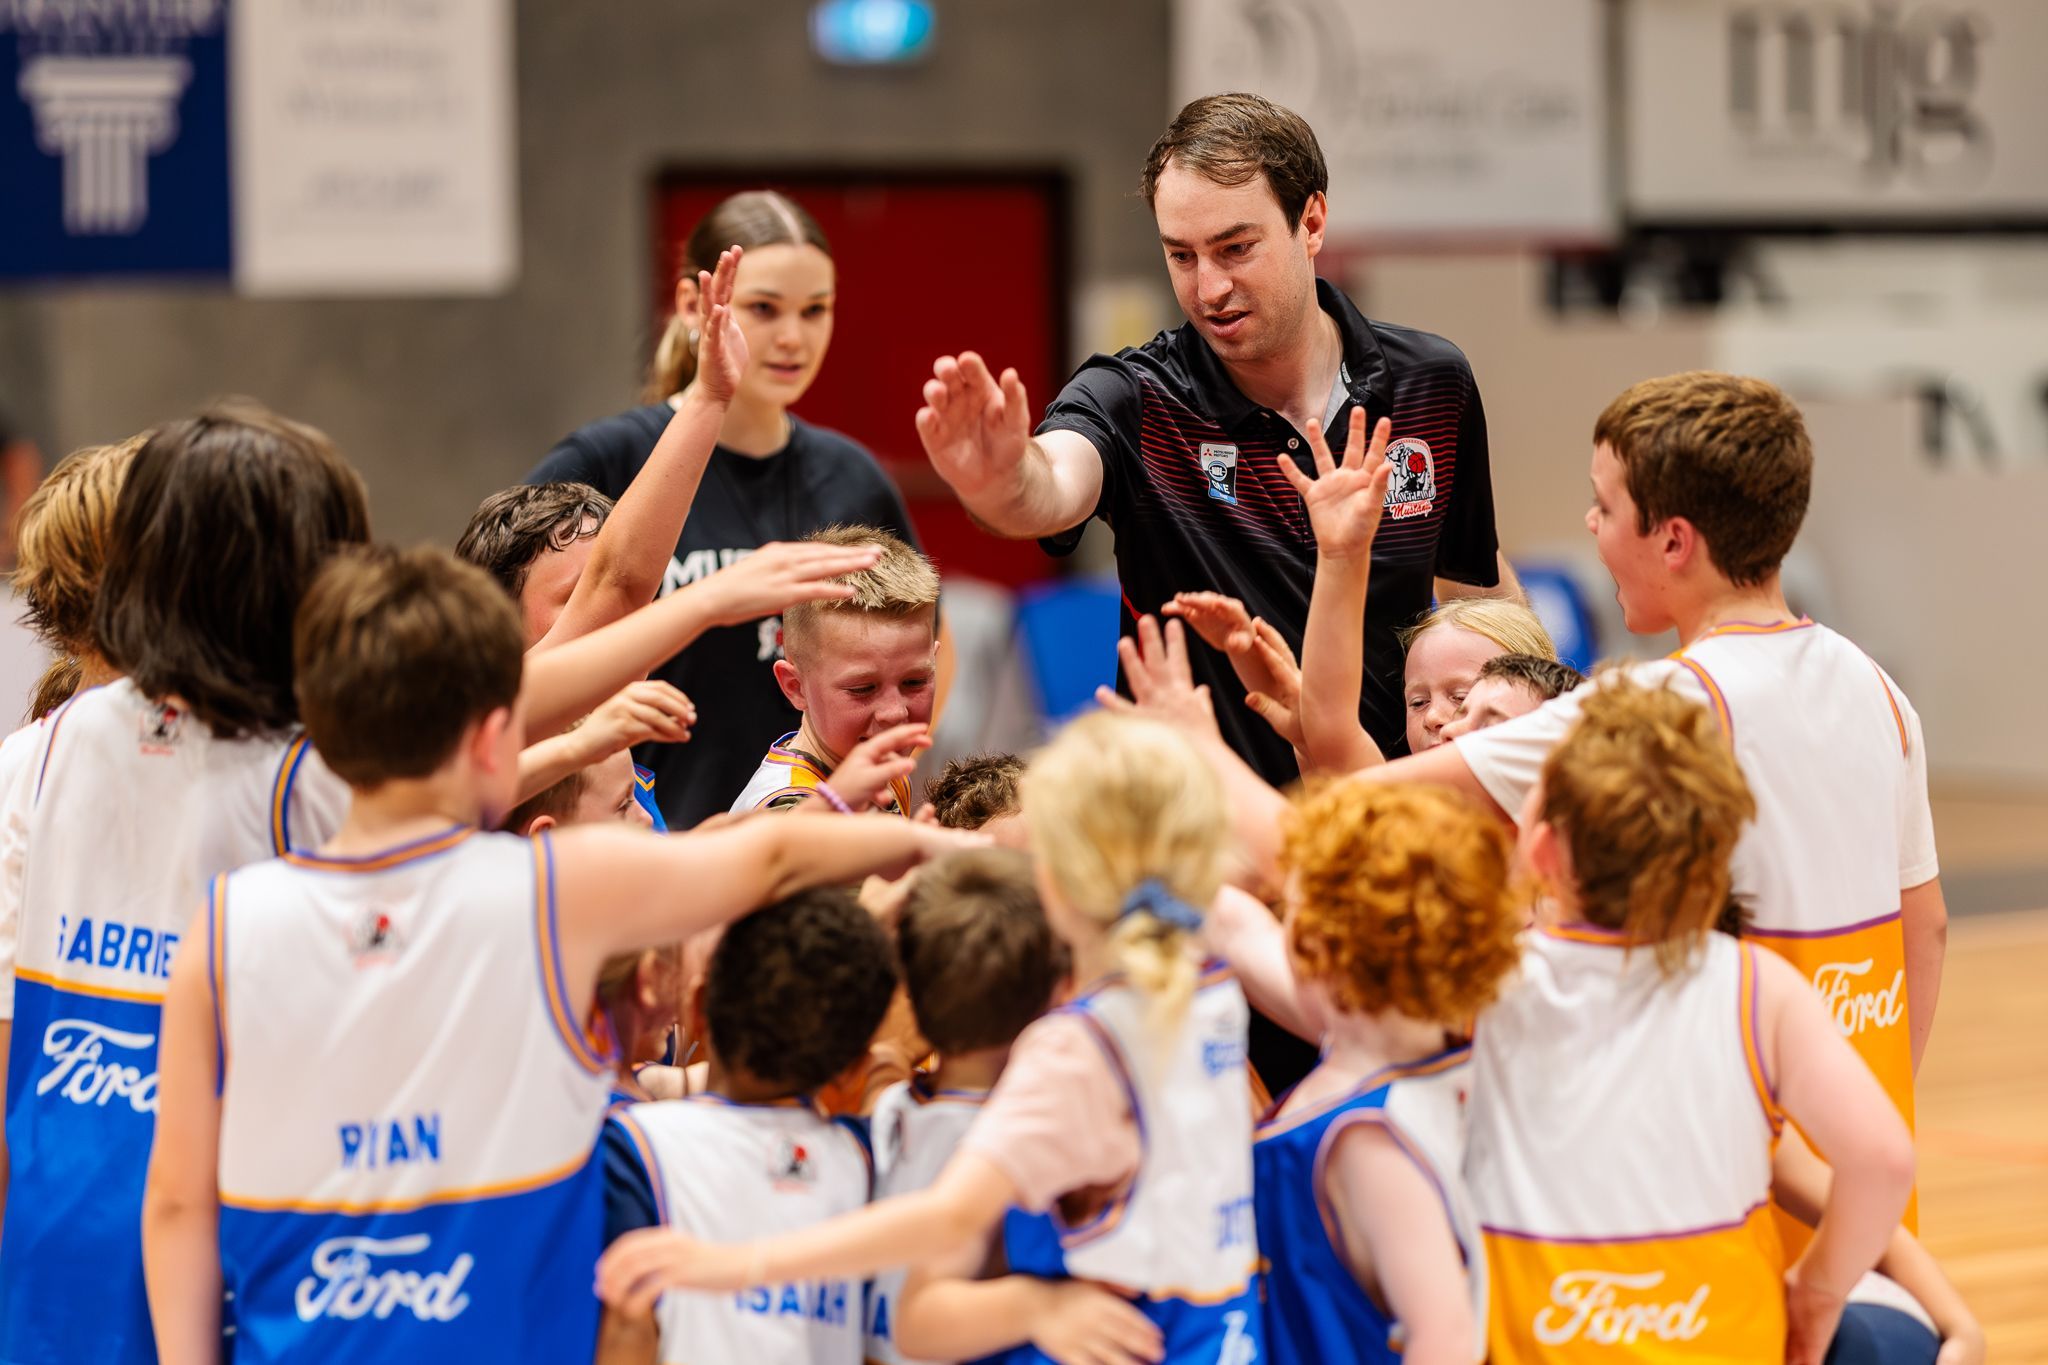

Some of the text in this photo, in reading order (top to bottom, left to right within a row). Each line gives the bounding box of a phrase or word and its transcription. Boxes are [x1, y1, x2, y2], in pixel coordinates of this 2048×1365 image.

[58, 914, 179, 978] ABRIE
[1812, 957, 1904, 1038] Ford
[295, 1233, 474, 1322] Ford
[1533, 1270, 1710, 1346] Ford
